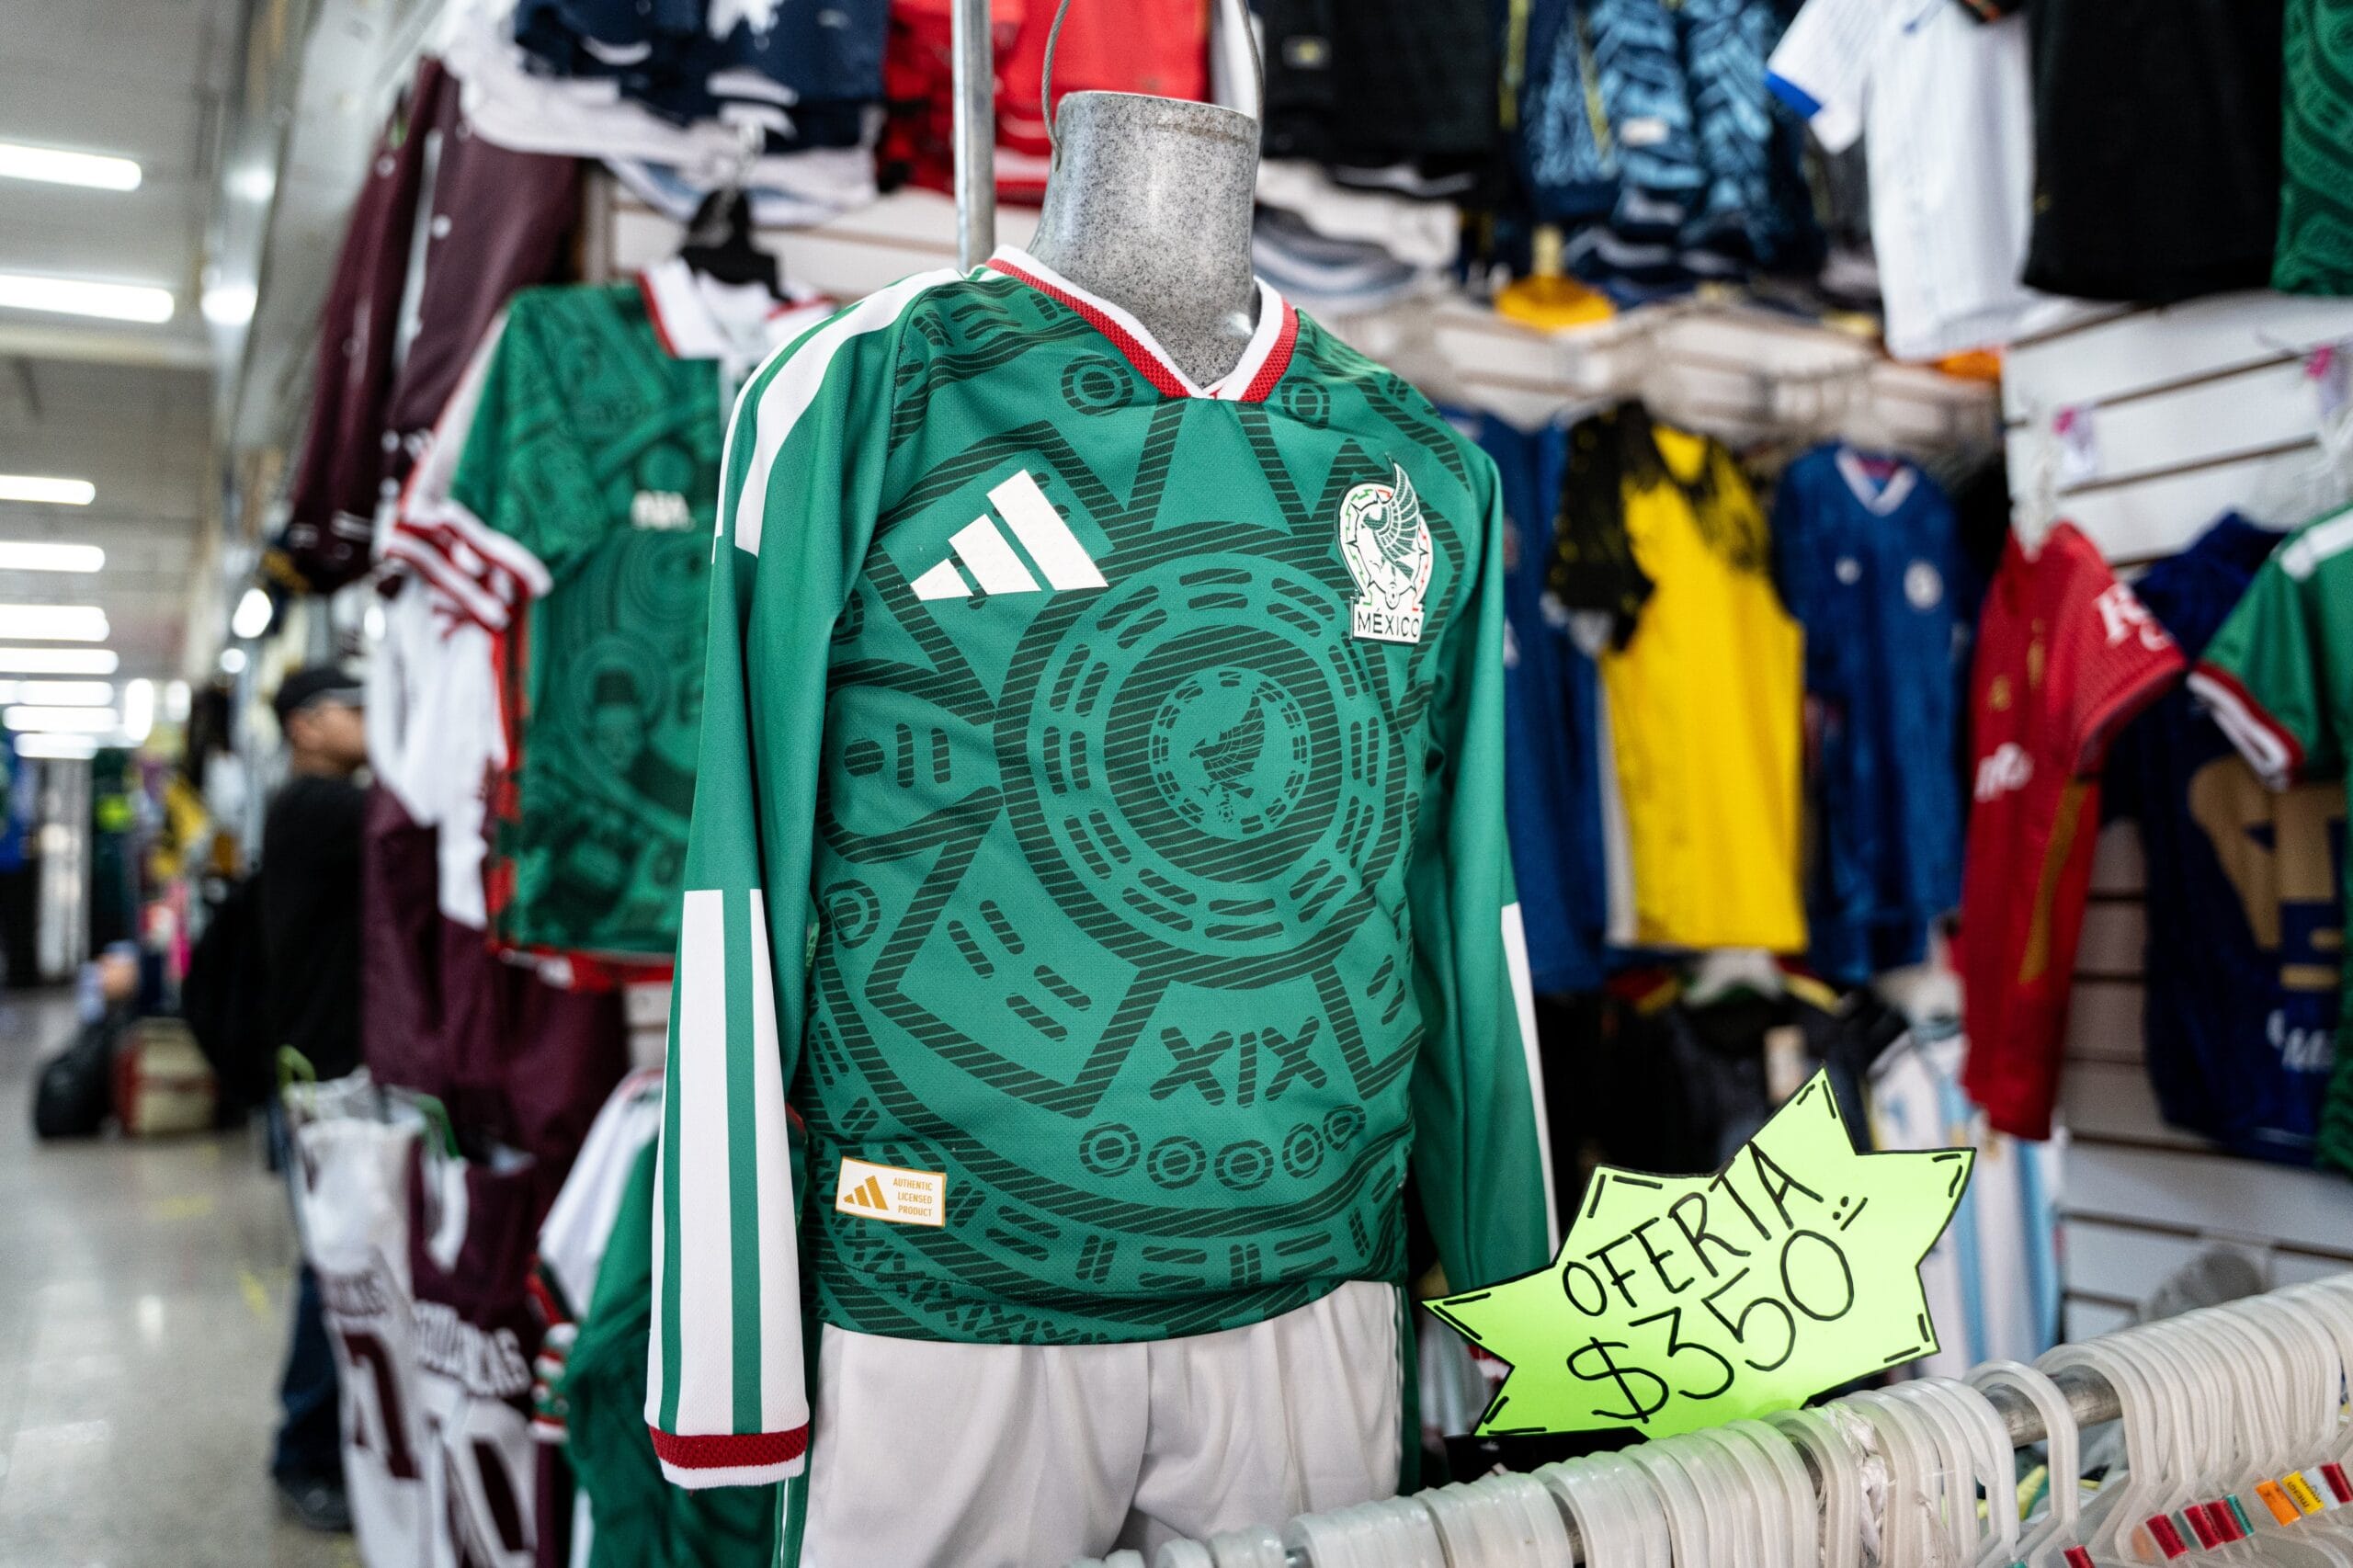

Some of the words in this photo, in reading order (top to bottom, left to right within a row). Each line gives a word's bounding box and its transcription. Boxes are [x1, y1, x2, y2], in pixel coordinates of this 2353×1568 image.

[1358, 608, 1420, 638] MÉXICO
[893, 1177, 933, 1191] AUTHENTIC
[898, 1192, 933, 1204] LICENSED
[898, 1205, 932, 1217] PRODUCT
[1562, 1140, 1825, 1317] OFERTA
[1565, 1229, 1855, 1425] $350
